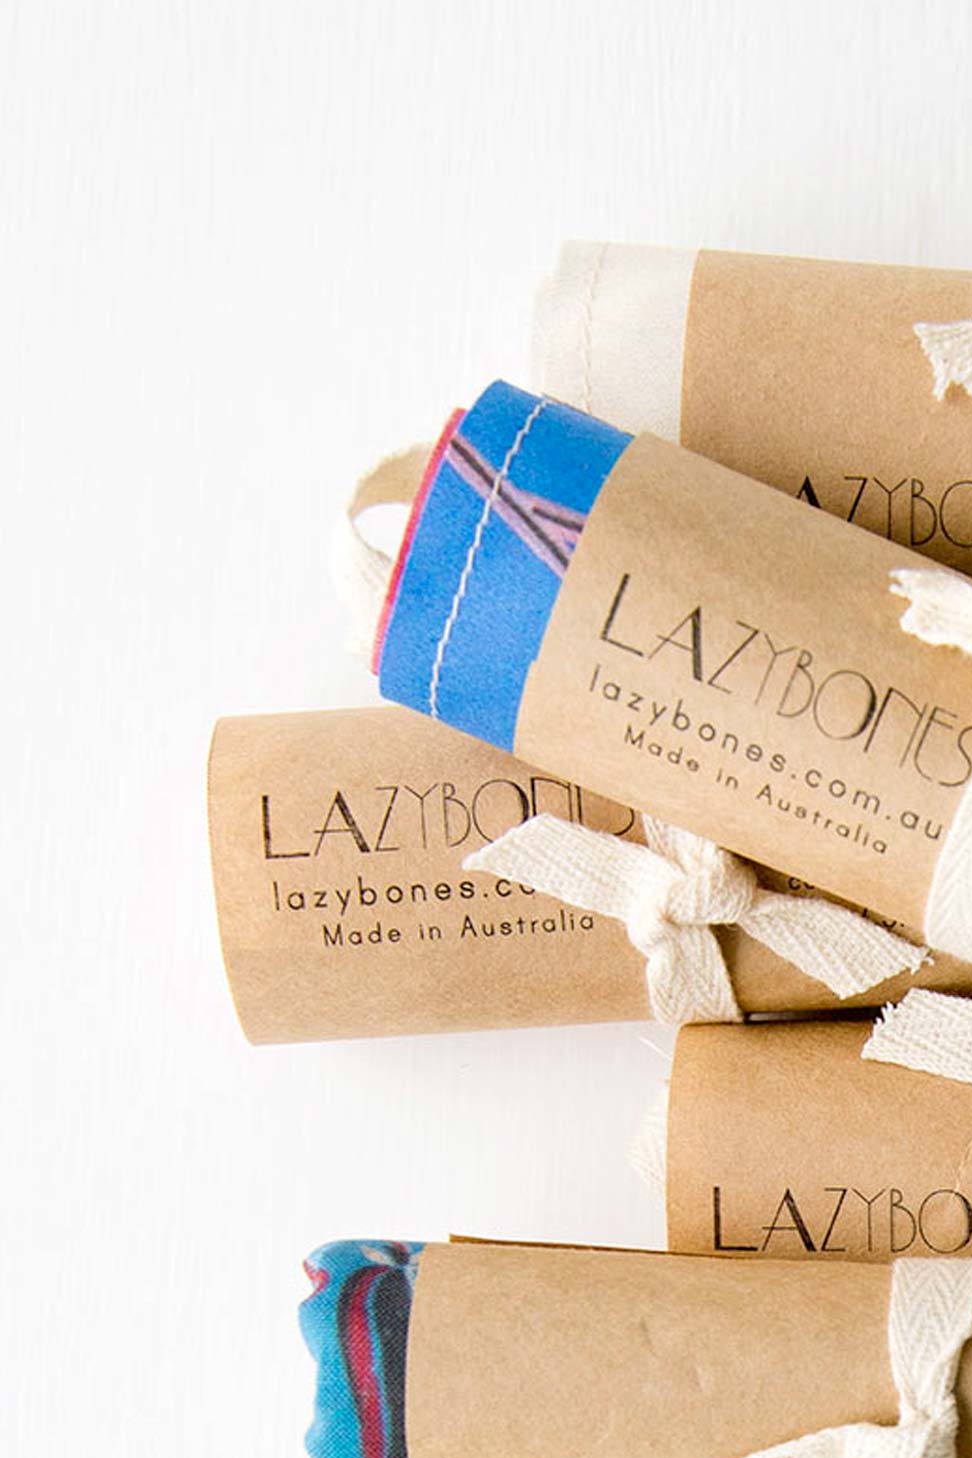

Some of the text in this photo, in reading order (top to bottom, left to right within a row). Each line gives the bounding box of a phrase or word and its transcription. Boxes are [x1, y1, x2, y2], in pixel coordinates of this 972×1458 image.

[589, 664, 944, 842] lazybones.com.au
[623, 723, 889, 855] Made in Australia
[323, 909, 595, 947] Made in Australia
